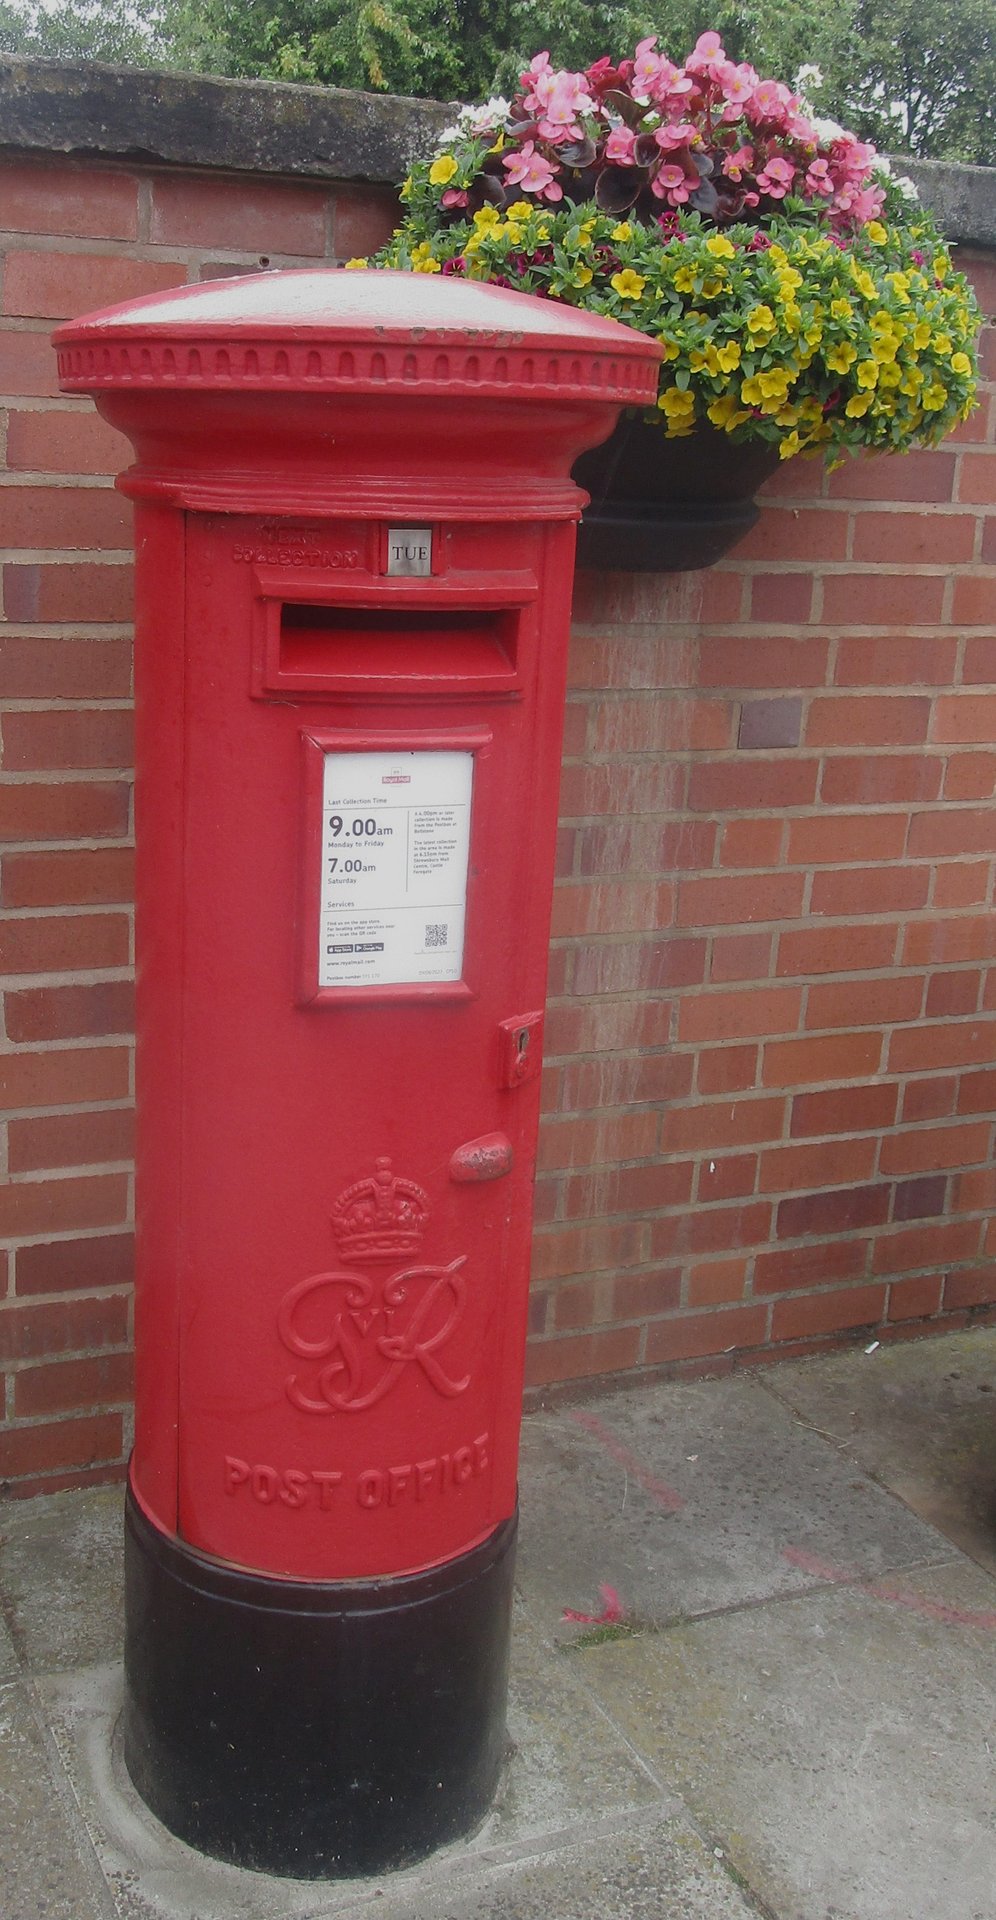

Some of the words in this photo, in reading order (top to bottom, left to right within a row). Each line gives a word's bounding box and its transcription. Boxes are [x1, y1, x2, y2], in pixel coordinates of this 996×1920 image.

[232, 543, 359, 569] COLLECTION
[392, 546, 429, 561] TUE
[329, 815, 393, 838] 9.00am
[364, 840, 385, 848] Friday
[327, 858, 376, 873] 7.00am
[327, 877, 357, 885] Saturday
[327, 900, 355, 908] Services
[224, 1454, 342, 1511] POST
[357, 1431, 490, 1509] OFFICE
